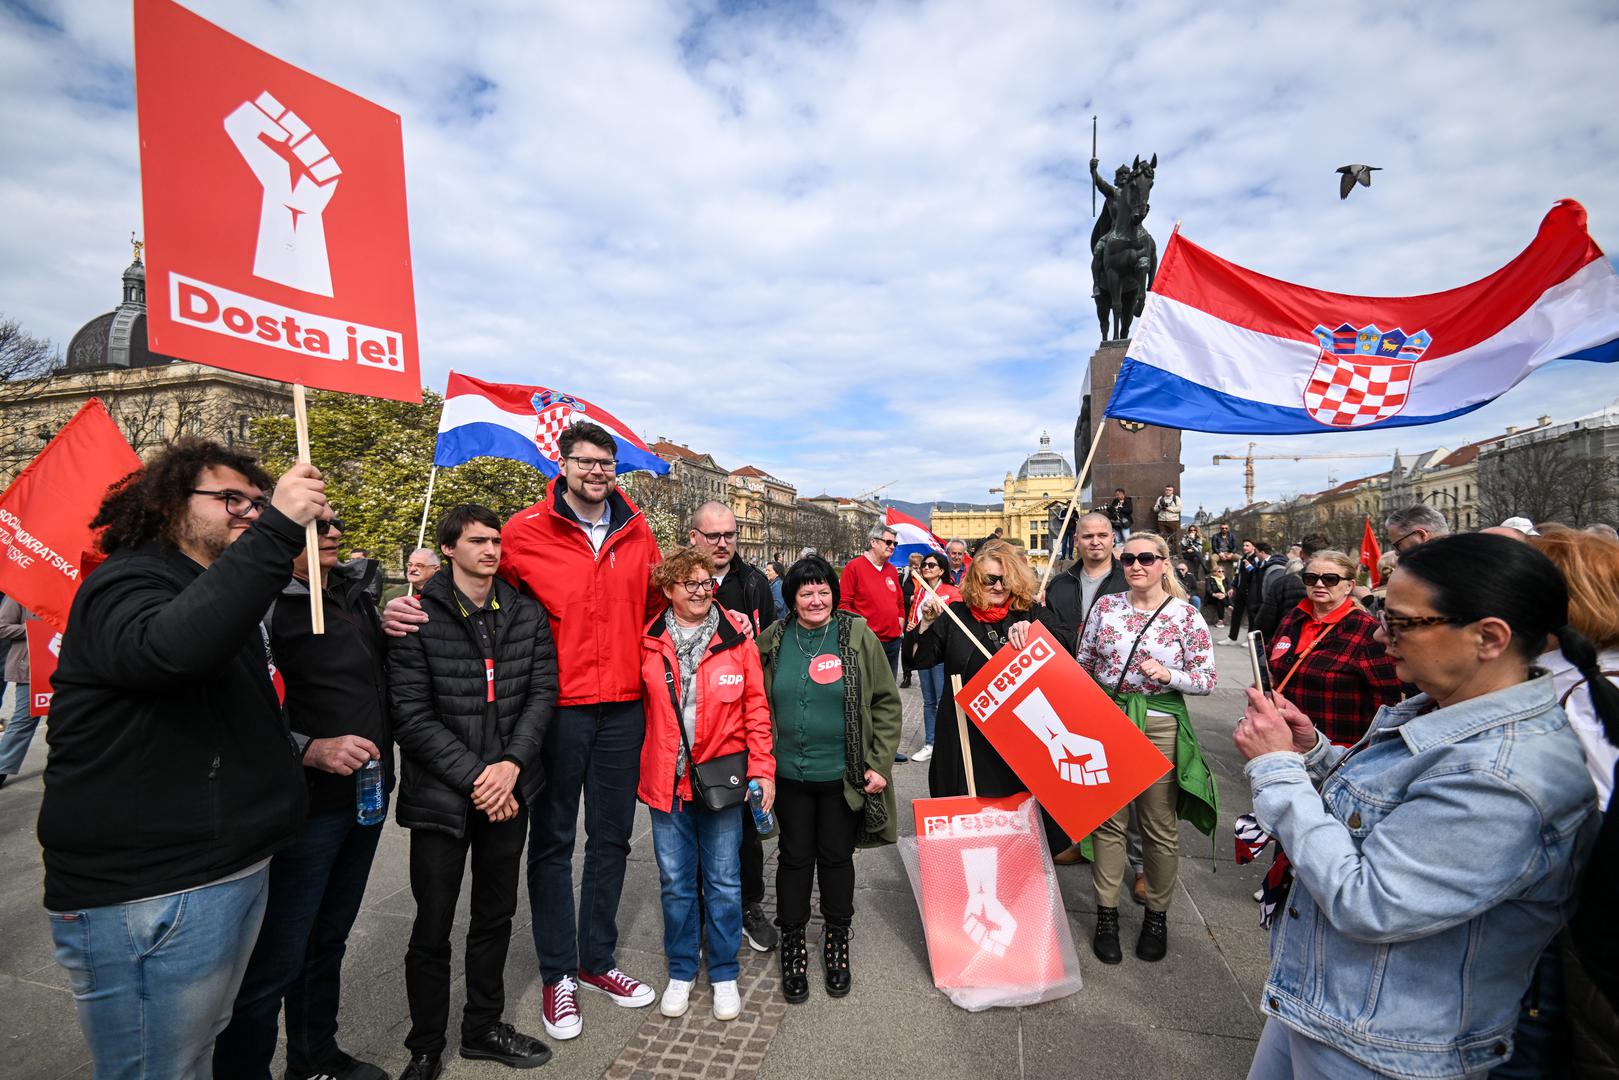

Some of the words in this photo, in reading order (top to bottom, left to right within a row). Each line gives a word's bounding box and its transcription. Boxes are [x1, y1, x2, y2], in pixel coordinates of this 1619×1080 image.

[178, 281, 330, 354] Dosta
[342, 325, 399, 367] je!
[718, 674, 744, 685] SDP
[817, 659, 842, 671] SDP
[993, 640, 1052, 692] Dosta
[973, 684, 1000, 718] je!
